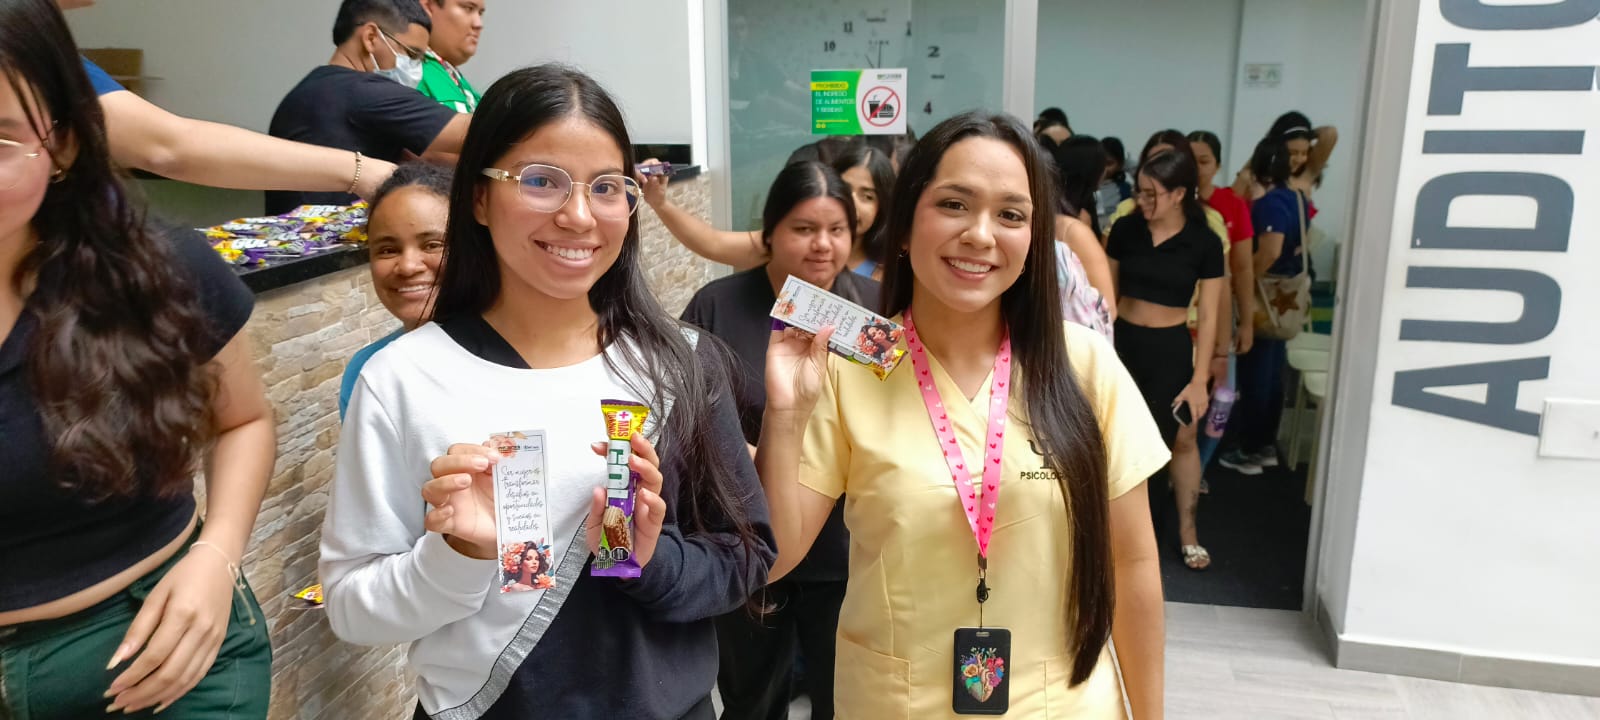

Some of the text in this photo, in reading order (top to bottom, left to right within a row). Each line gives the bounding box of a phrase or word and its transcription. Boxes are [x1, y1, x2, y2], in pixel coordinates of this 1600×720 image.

[824, 40, 836, 52] 10
[927, 46, 940, 58] 2
[922, 101, 932, 115] 4
